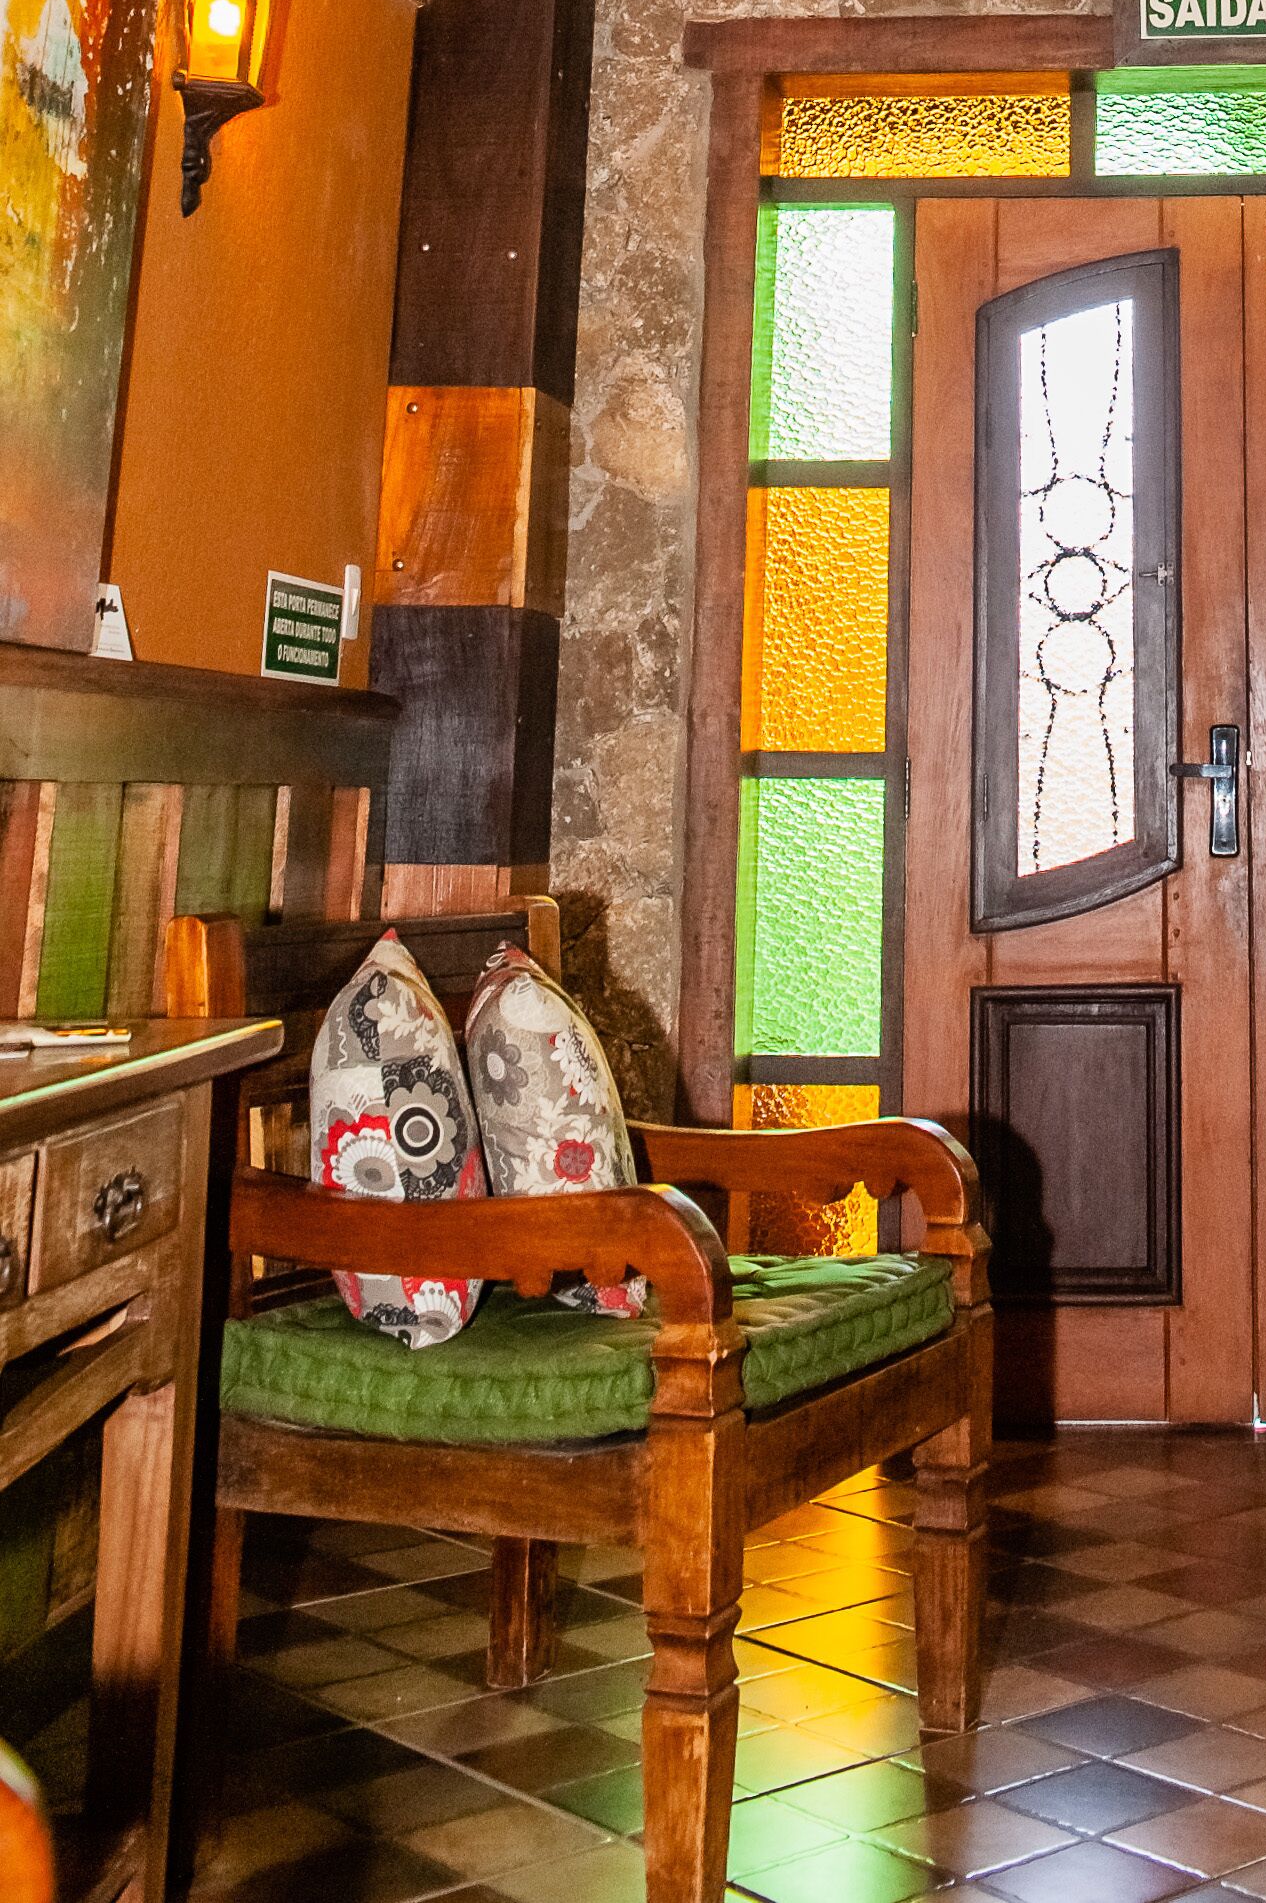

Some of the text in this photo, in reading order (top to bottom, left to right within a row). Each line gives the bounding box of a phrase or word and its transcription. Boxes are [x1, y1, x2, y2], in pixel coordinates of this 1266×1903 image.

[273, 590, 340, 620] ESTA PORTA PERMANECE
[272, 617, 337, 644] ABERTA DURANTE TODO
[277, 644, 329, 667] O FUNCIONAMENTO
